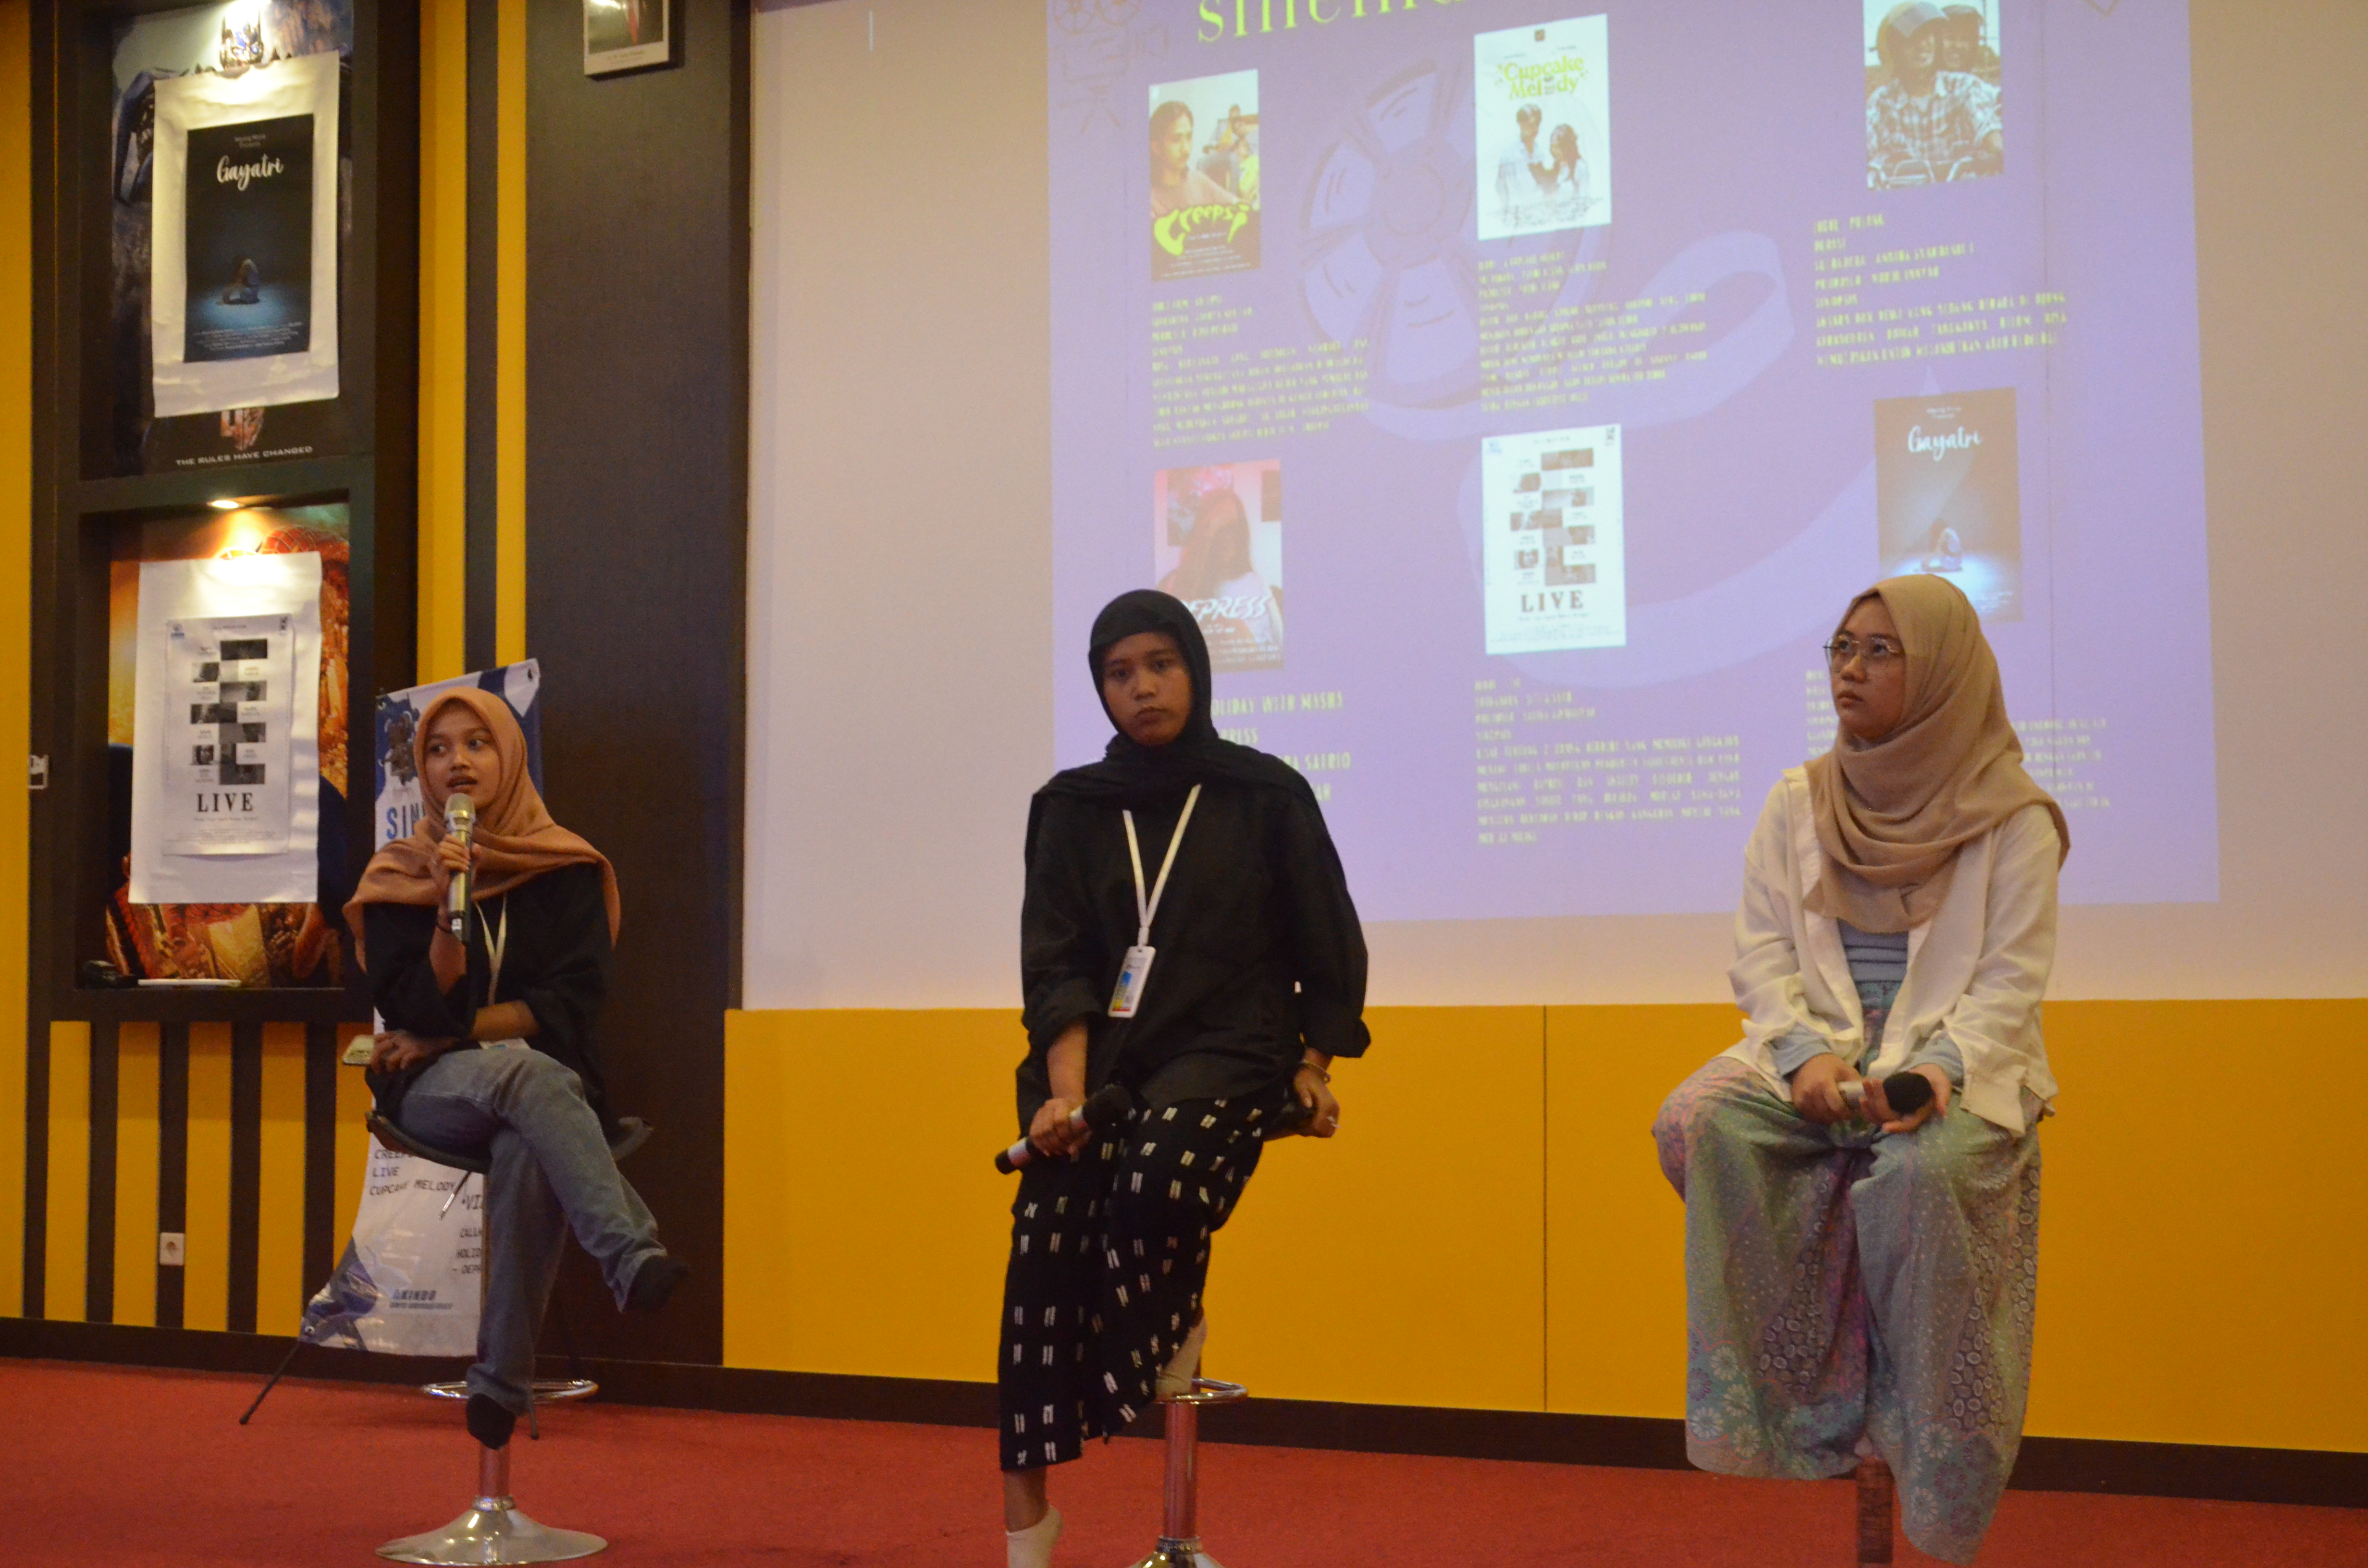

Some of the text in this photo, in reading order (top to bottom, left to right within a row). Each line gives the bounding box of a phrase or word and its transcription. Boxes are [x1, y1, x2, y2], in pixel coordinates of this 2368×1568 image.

[217, 153, 284, 191] Gayatri
[1908, 426, 1982, 462] Gayatri
[176, 446, 313, 466] THE RULES HAVE CHANGED
[1521, 590, 1584, 612] LIVE
[1211, 697, 1255, 716] OLIDAY
[197, 792, 253, 812] LIVE
[372, 1167, 400, 1177] LIVE
